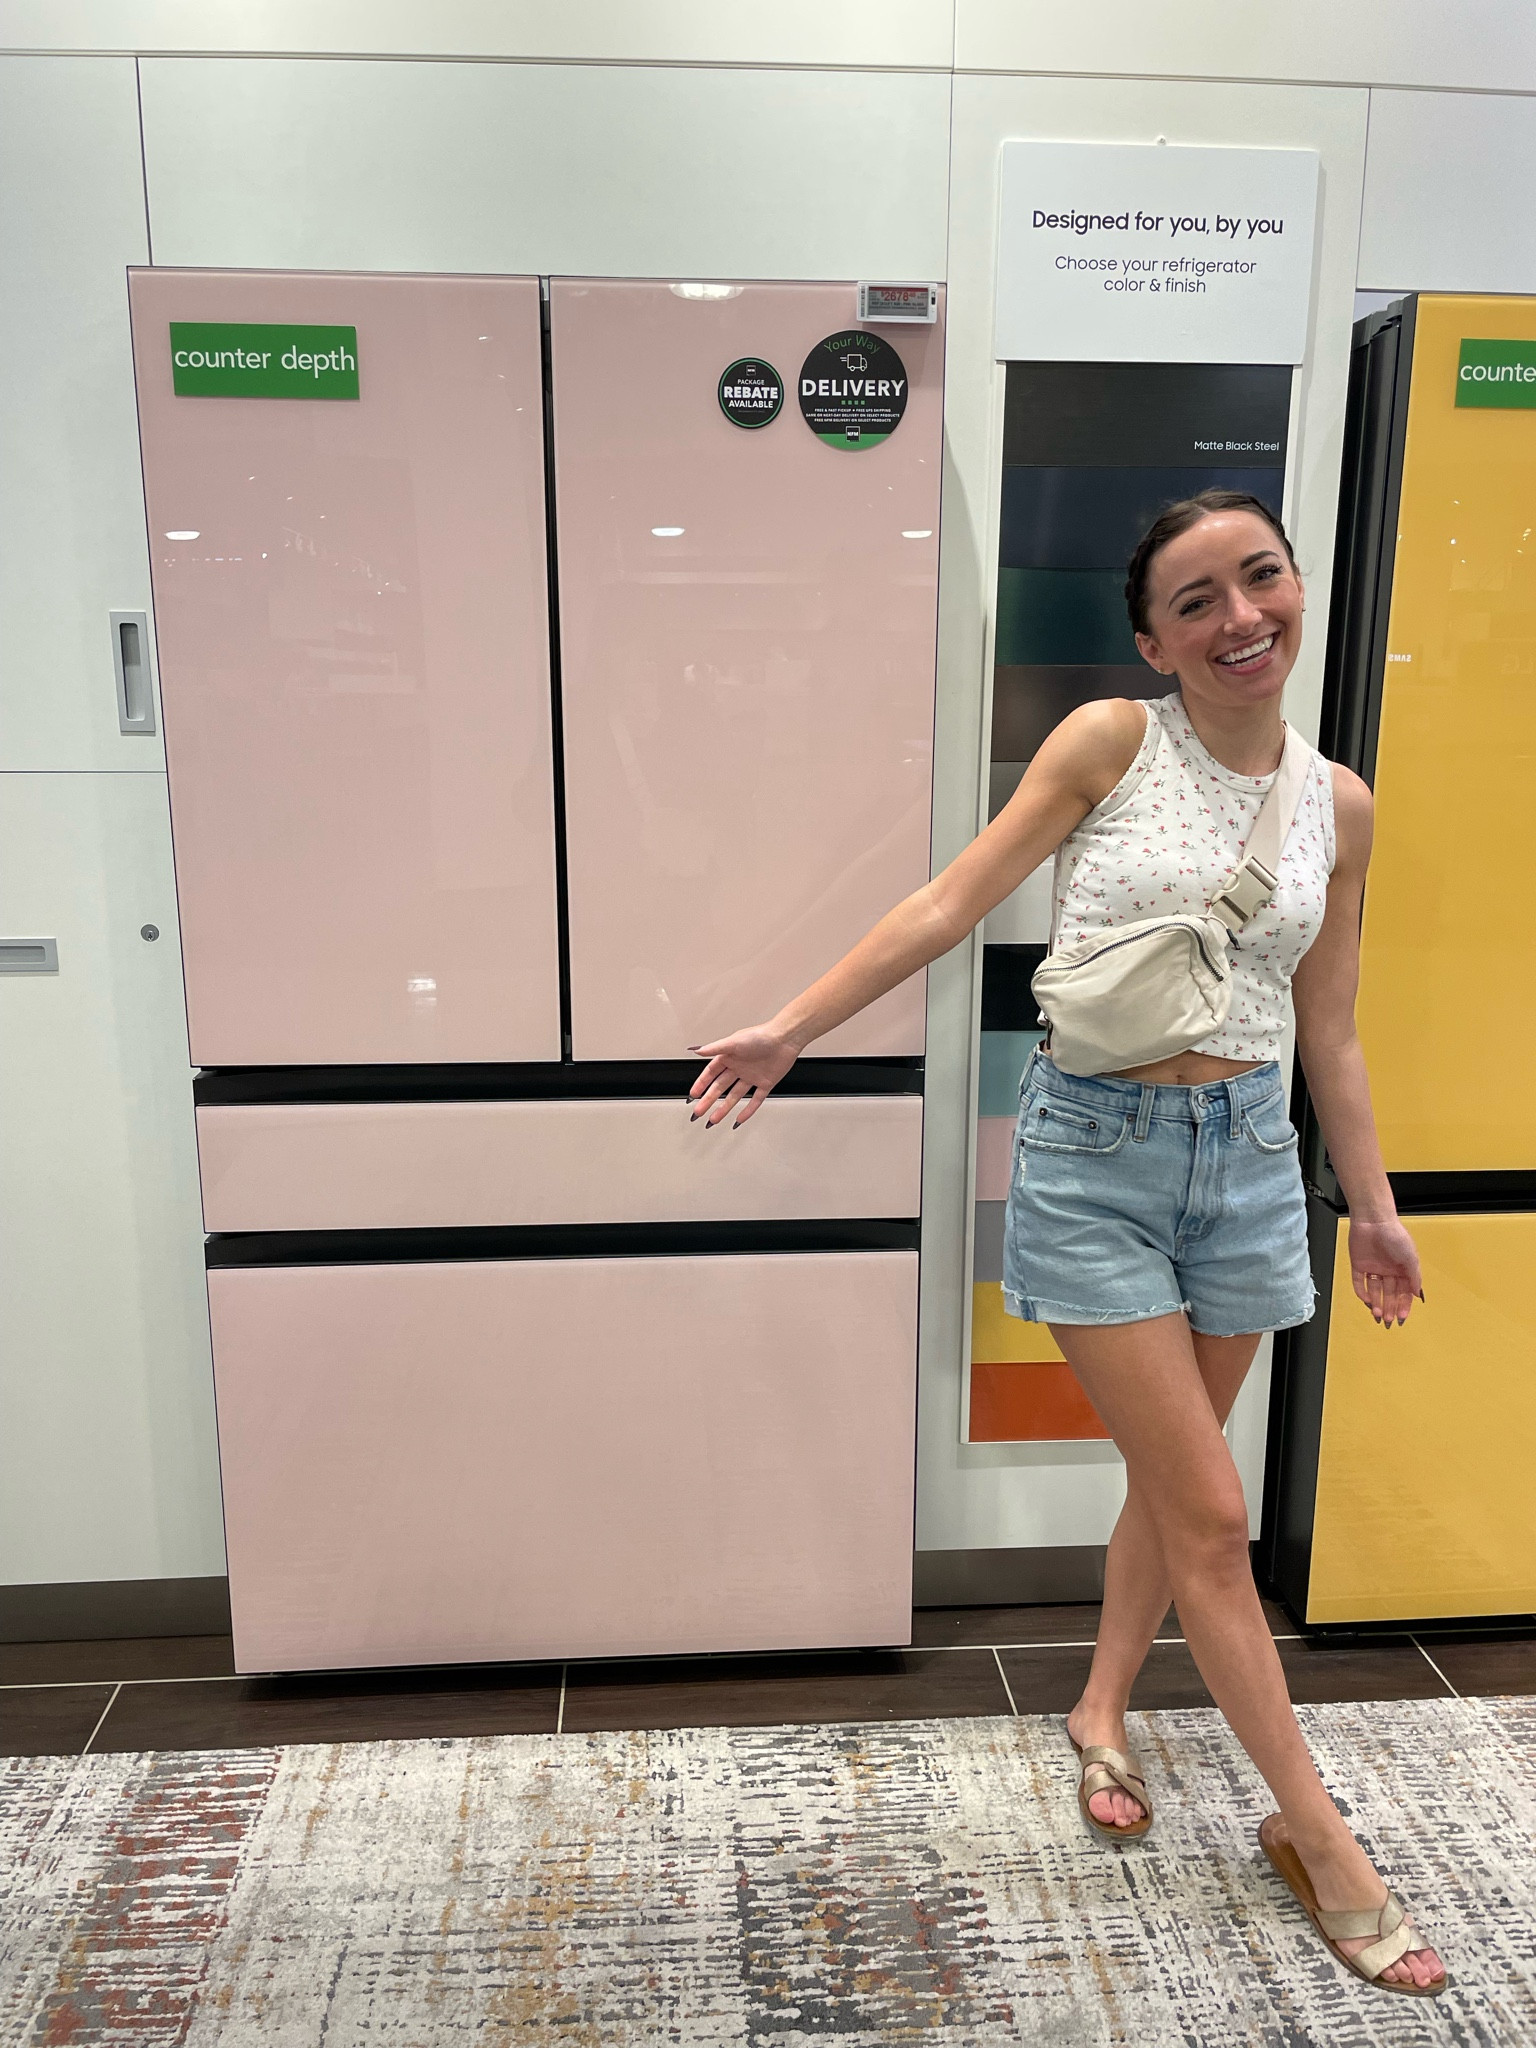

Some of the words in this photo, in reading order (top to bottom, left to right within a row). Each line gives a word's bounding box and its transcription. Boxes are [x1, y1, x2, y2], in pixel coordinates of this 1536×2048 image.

[1032, 209, 1129, 235] Designed
[1134, 211, 1165, 231] for
[1169, 216, 1210, 238] you,
[1215, 214, 1241, 239] by
[1246, 218, 1284, 239] you
[1054, 255, 1118, 271] Choose
[1122, 260, 1159, 275] your
[1162, 257, 1257, 277] refrigerator
[1103, 277, 1146, 292] color
[1149, 278, 1161, 292] &
[1165, 277, 1206, 293] finish
[823, 337, 852, 353] Your
[855, 334, 881, 355] Way
[174, 347, 272, 369] counter
[280, 344, 355, 379] depth
[1460, 362, 1536, 383] counte
[737, 378, 765, 386] PACKAGE
[801, 379, 906, 397] DELIVERY
[723, 386, 779, 399] REBATE
[728, 399, 774, 409] AVAILABLE
[1194, 441, 1224, 450] Matte
[1225, 441, 1253, 451] Black
[1254, 441, 1280, 451] Steel
